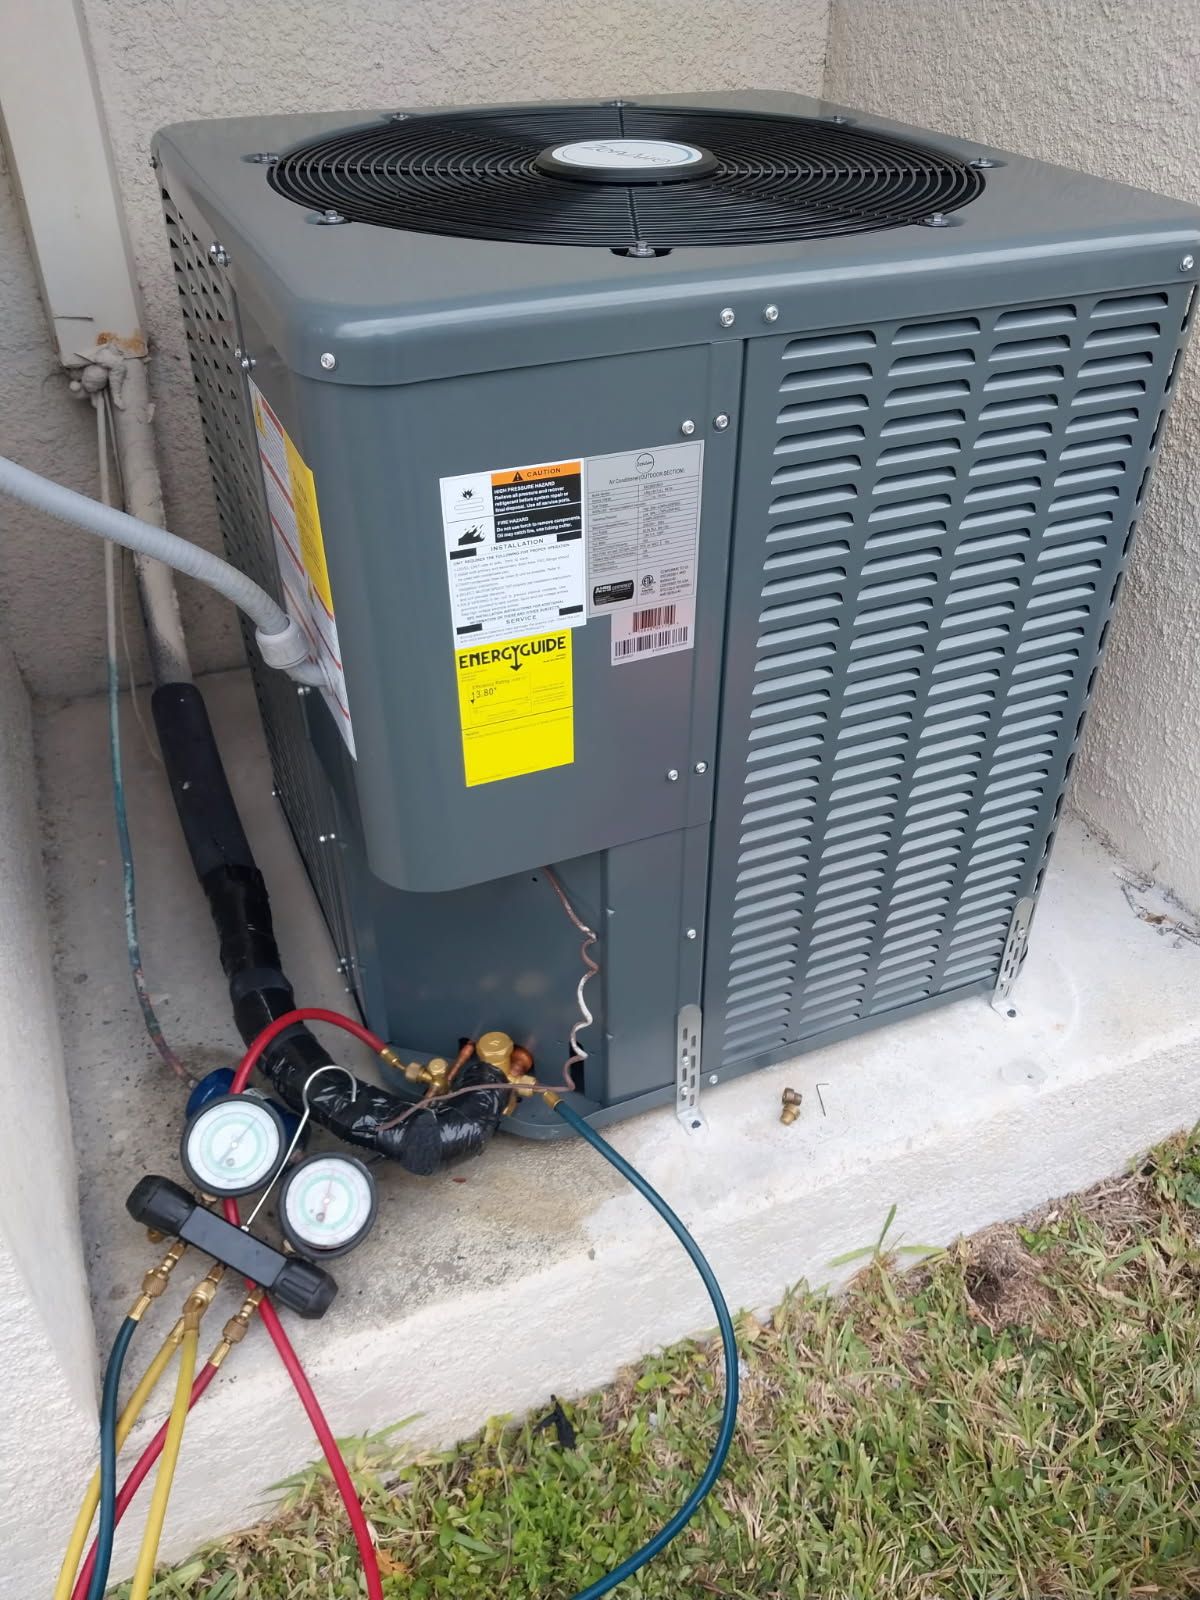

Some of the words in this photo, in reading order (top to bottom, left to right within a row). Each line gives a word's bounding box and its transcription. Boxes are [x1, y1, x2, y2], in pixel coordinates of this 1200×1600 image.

[527, 468, 560, 477] CAUTION
[508, 483, 534, 492] PRESSURE
[490, 538, 544, 552] INSTALLATION
[506, 615, 537, 625] SERVICE
[459, 636, 567, 671] ENERGYGUIDE
